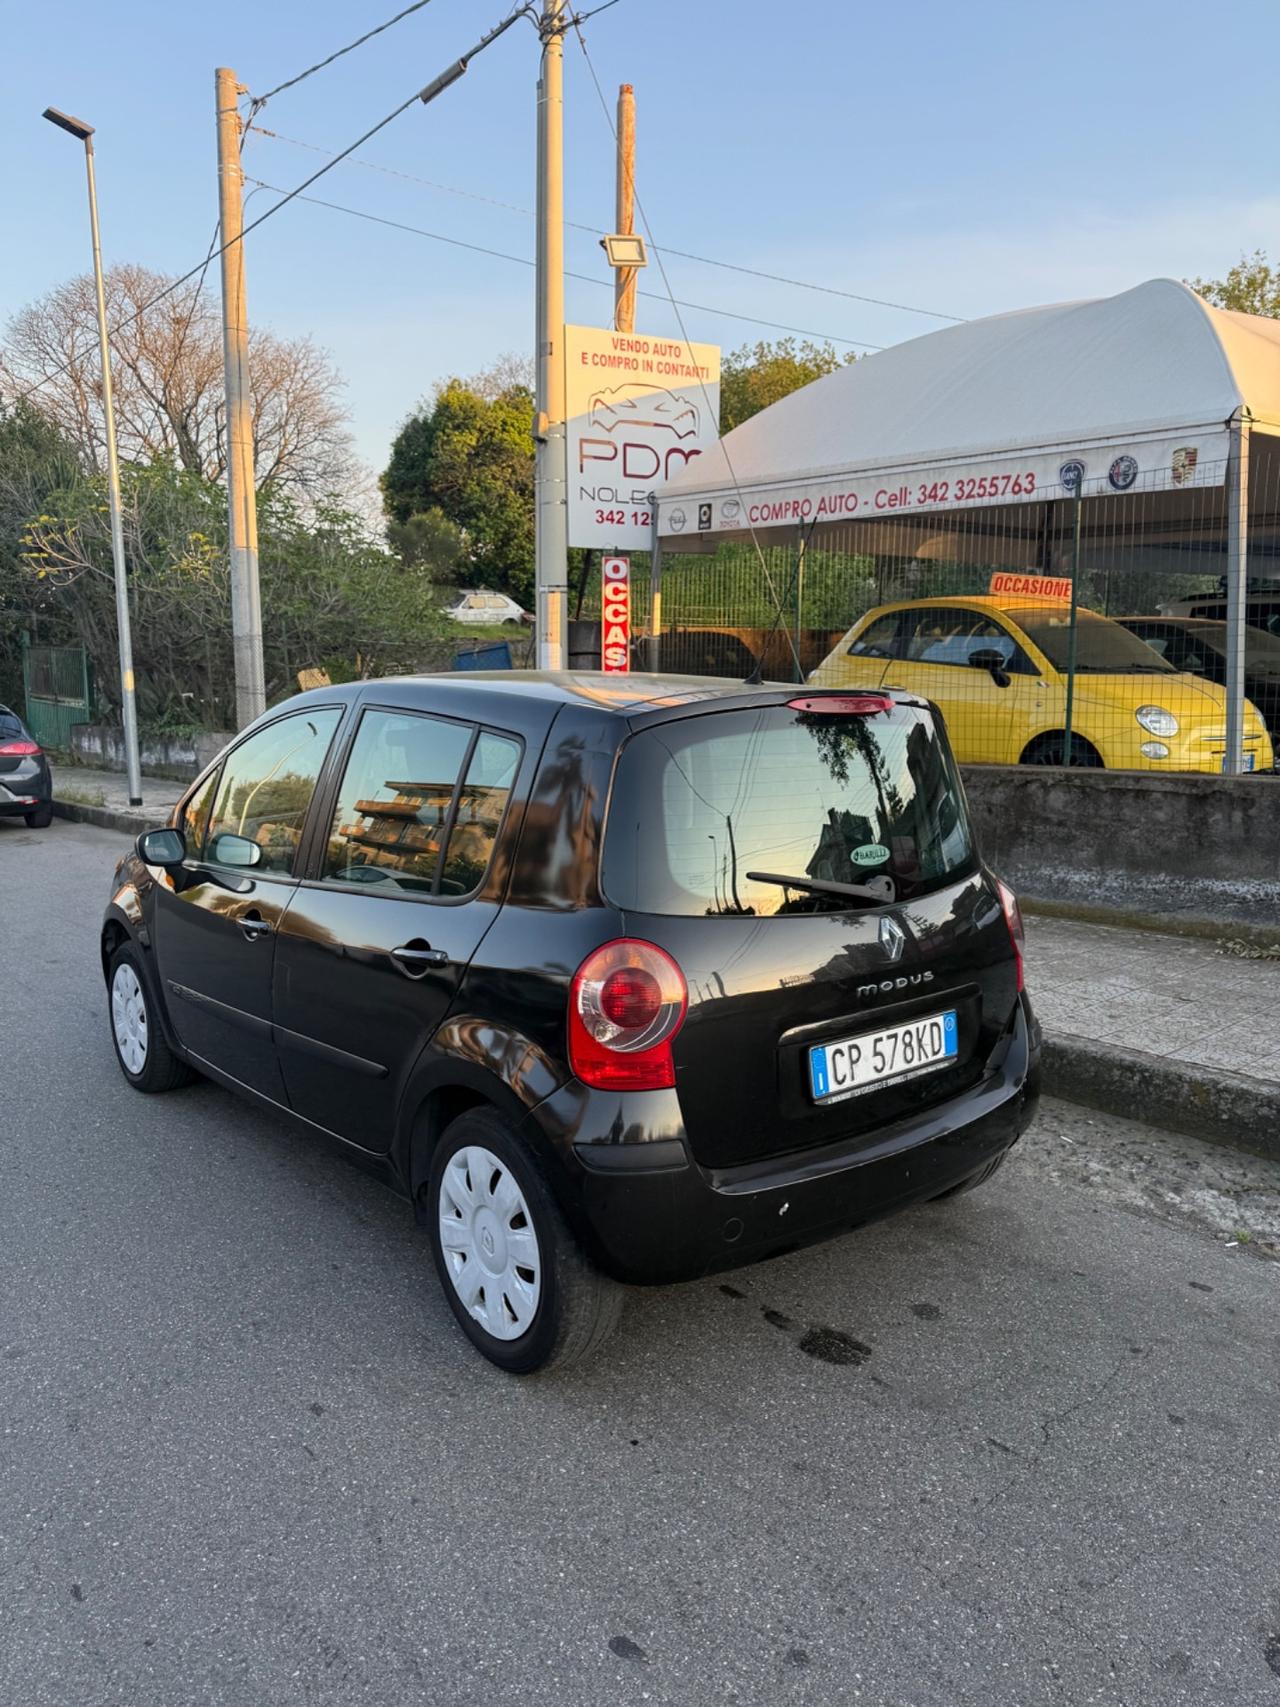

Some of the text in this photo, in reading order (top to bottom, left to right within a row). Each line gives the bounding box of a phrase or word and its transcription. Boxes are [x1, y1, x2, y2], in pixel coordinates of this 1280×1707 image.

[612, 337, 681, 358] VENDO AUTO
[581, 352, 709, 379] E COMPRO IN CONTANTI
[750, 498, 812, 522] COMPRO
[817, 493, 858, 515] AUTO
[875, 486, 912, 509] Cell:
[917, 481, 949, 505] 342
[954, 472, 1035, 500] 3255763
[595, 509, 625, 524] 342
[994, 576, 1072, 597] OCCASIONE
[605, 560, 627, 672] OCCAS
[832, 1043, 861, 1085] CP
[872, 1022, 942, 1073] 578KD
